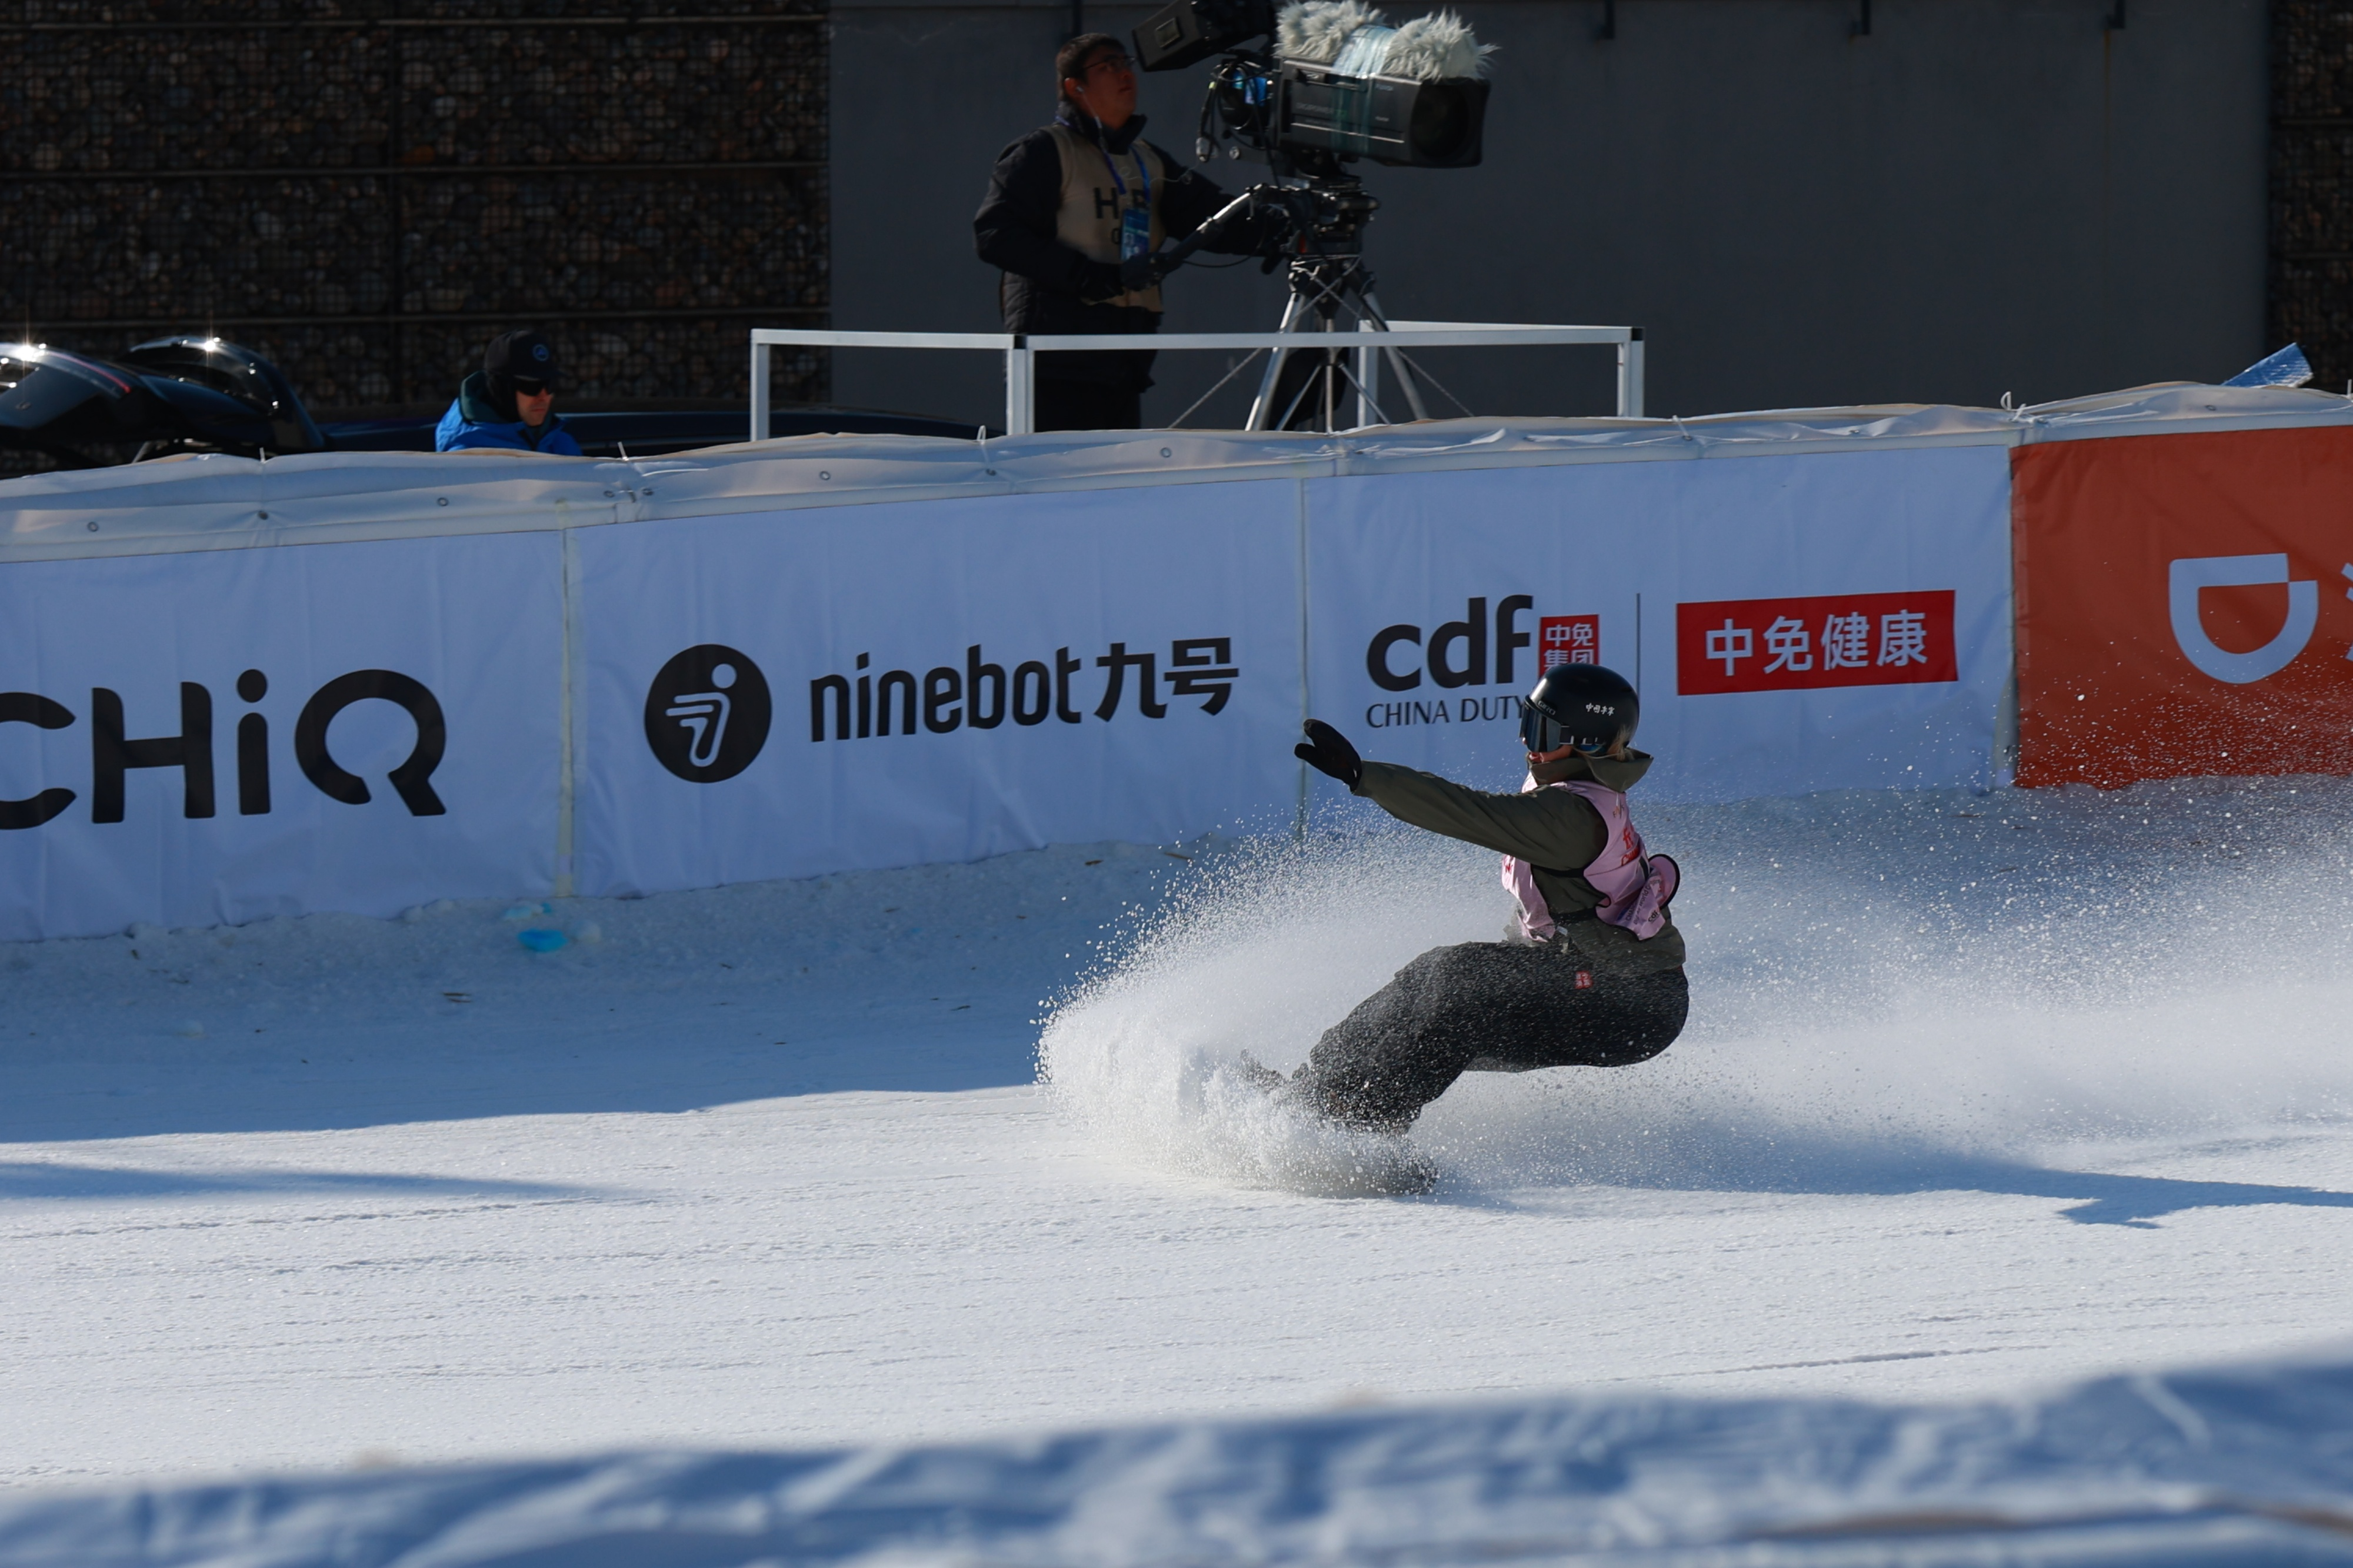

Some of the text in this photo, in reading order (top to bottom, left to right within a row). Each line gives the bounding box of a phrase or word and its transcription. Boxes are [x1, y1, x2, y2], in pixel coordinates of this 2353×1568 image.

[1366, 594, 1534, 692] cdf
[1545, 623, 1594, 647] 中免
[1705, 609, 1928, 676] 中免健康
[1366, 696, 1524, 728] CHINA DUTY
